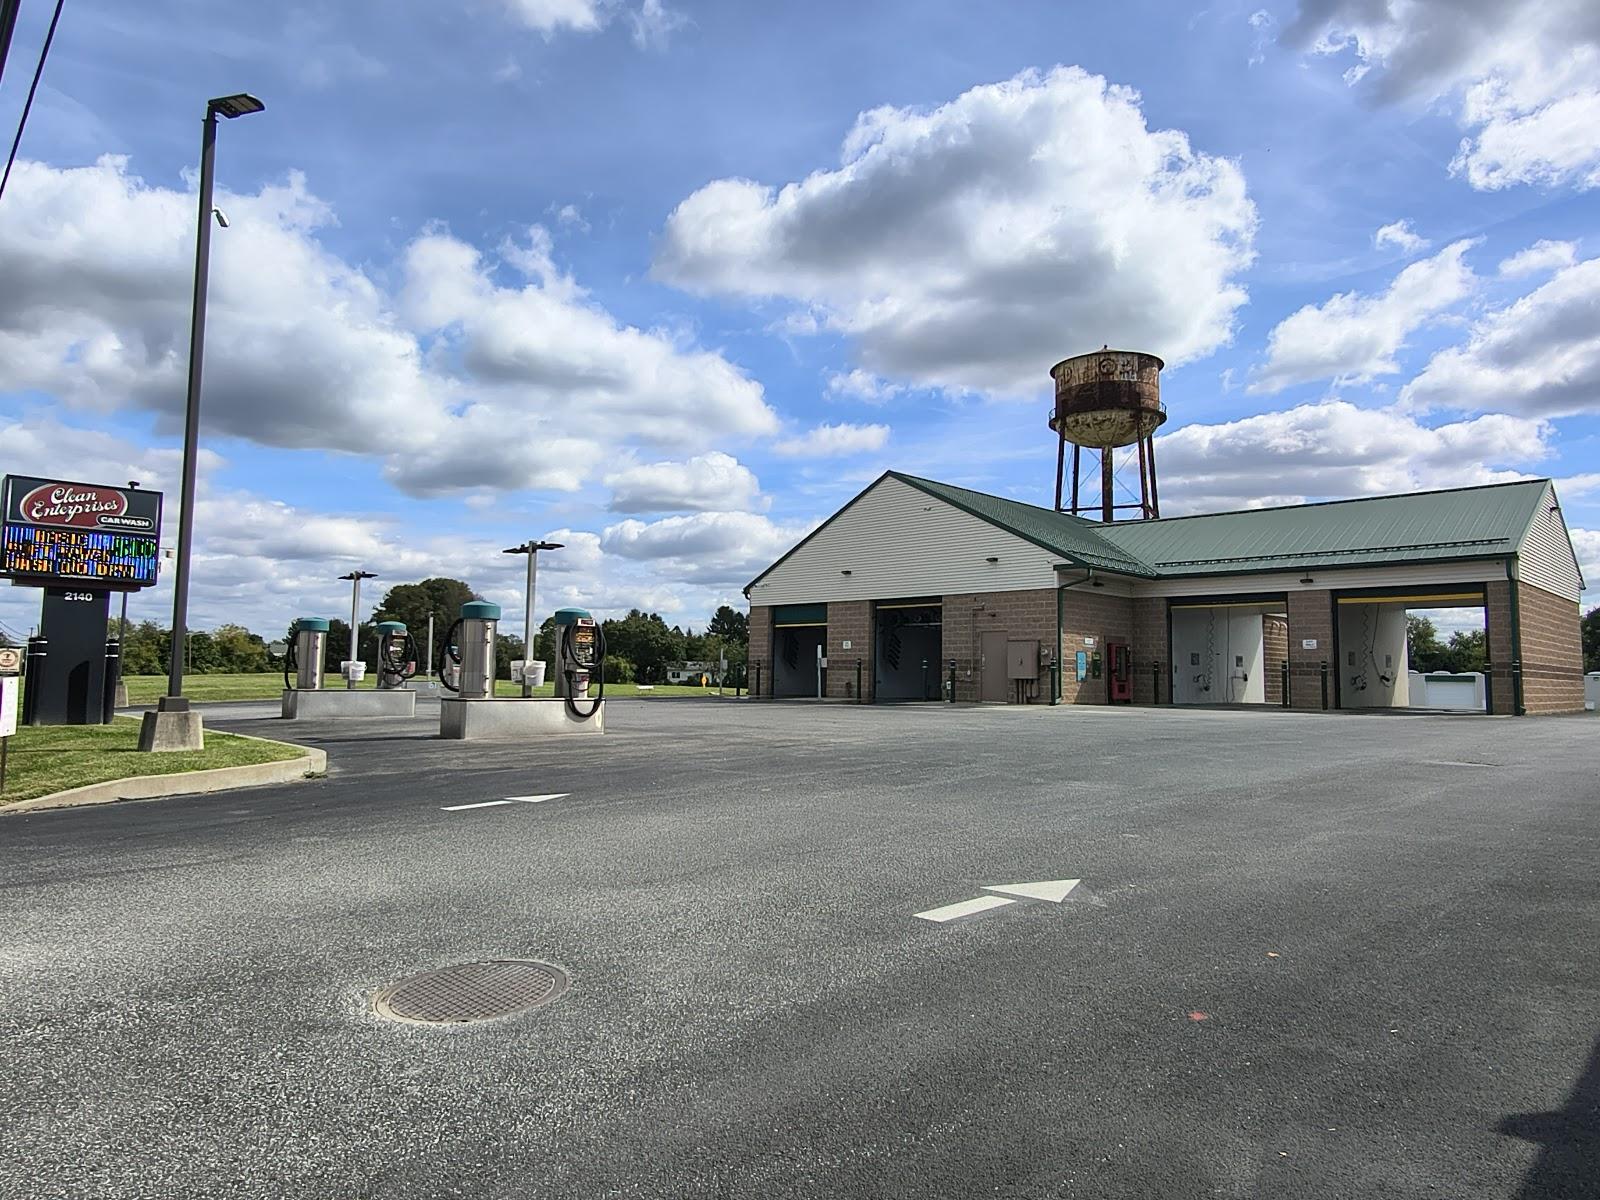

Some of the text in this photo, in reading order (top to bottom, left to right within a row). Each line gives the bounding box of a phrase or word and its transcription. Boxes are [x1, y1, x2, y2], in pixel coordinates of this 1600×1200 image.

[50, 487, 97, 504] Clean
[31, 500, 118, 522] Enterprises
[64, 591, 93, 601] 2140
